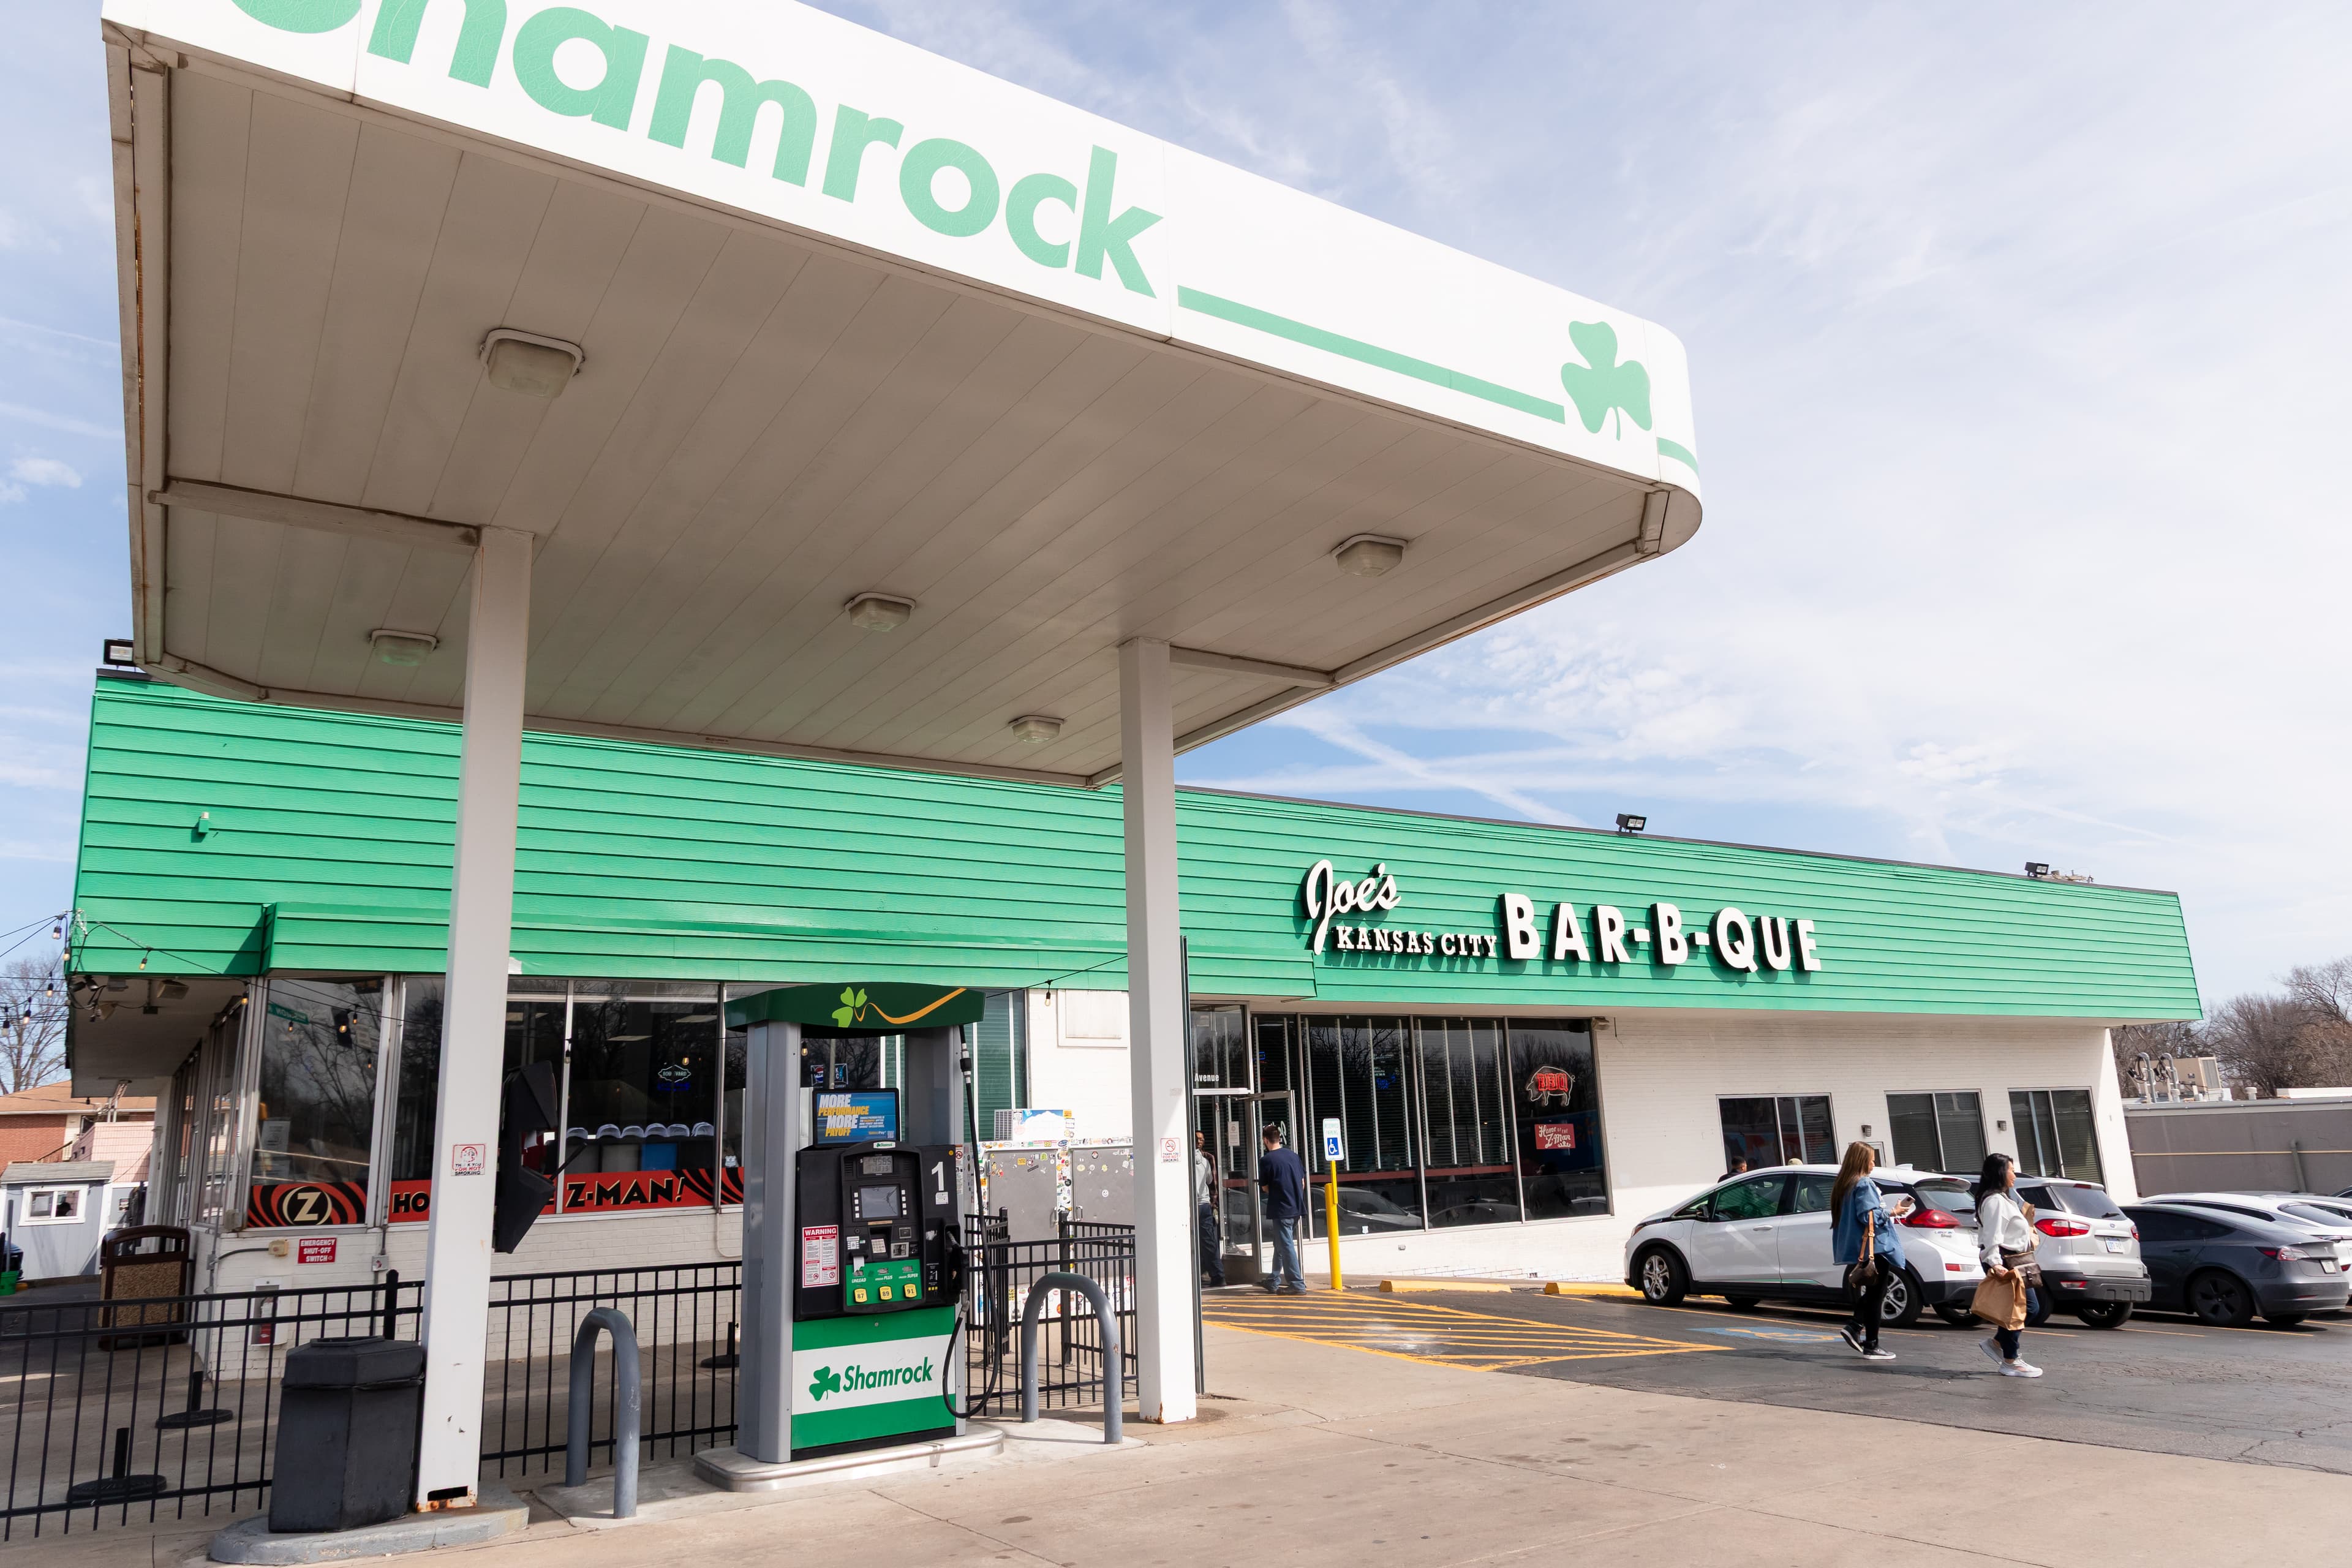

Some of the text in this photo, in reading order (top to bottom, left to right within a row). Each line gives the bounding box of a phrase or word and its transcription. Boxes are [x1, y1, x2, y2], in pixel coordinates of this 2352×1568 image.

[233, 0, 1161, 297] hamrock
[1306, 859, 1402, 956] Joe's
[1335, 925, 1498, 957] KANSAS CITY
[1503, 892, 1822, 973] BAR-B-QUE
[1194, 1072, 1219, 1082] Avenue
[1537, 1073, 1569, 1092] BBQ
[820, 1094, 851, 1108] MORE
[818, 1106, 870, 1116] PERFORMANCE
[826, 1114, 859, 1129] MORE
[1538, 1124, 1556, 1137] Home
[825, 1127, 851, 1137] PAYOFF
[931, 1161, 944, 1191] 1
[565, 1177, 685, 1208] Z-MAN!
[293, 1191, 322, 1221] Z
[805, 1227, 837, 1236] WARNING
[300, 1238, 336, 1247] EMERGENCY
[842, 1356, 934, 1392] Shamrock
